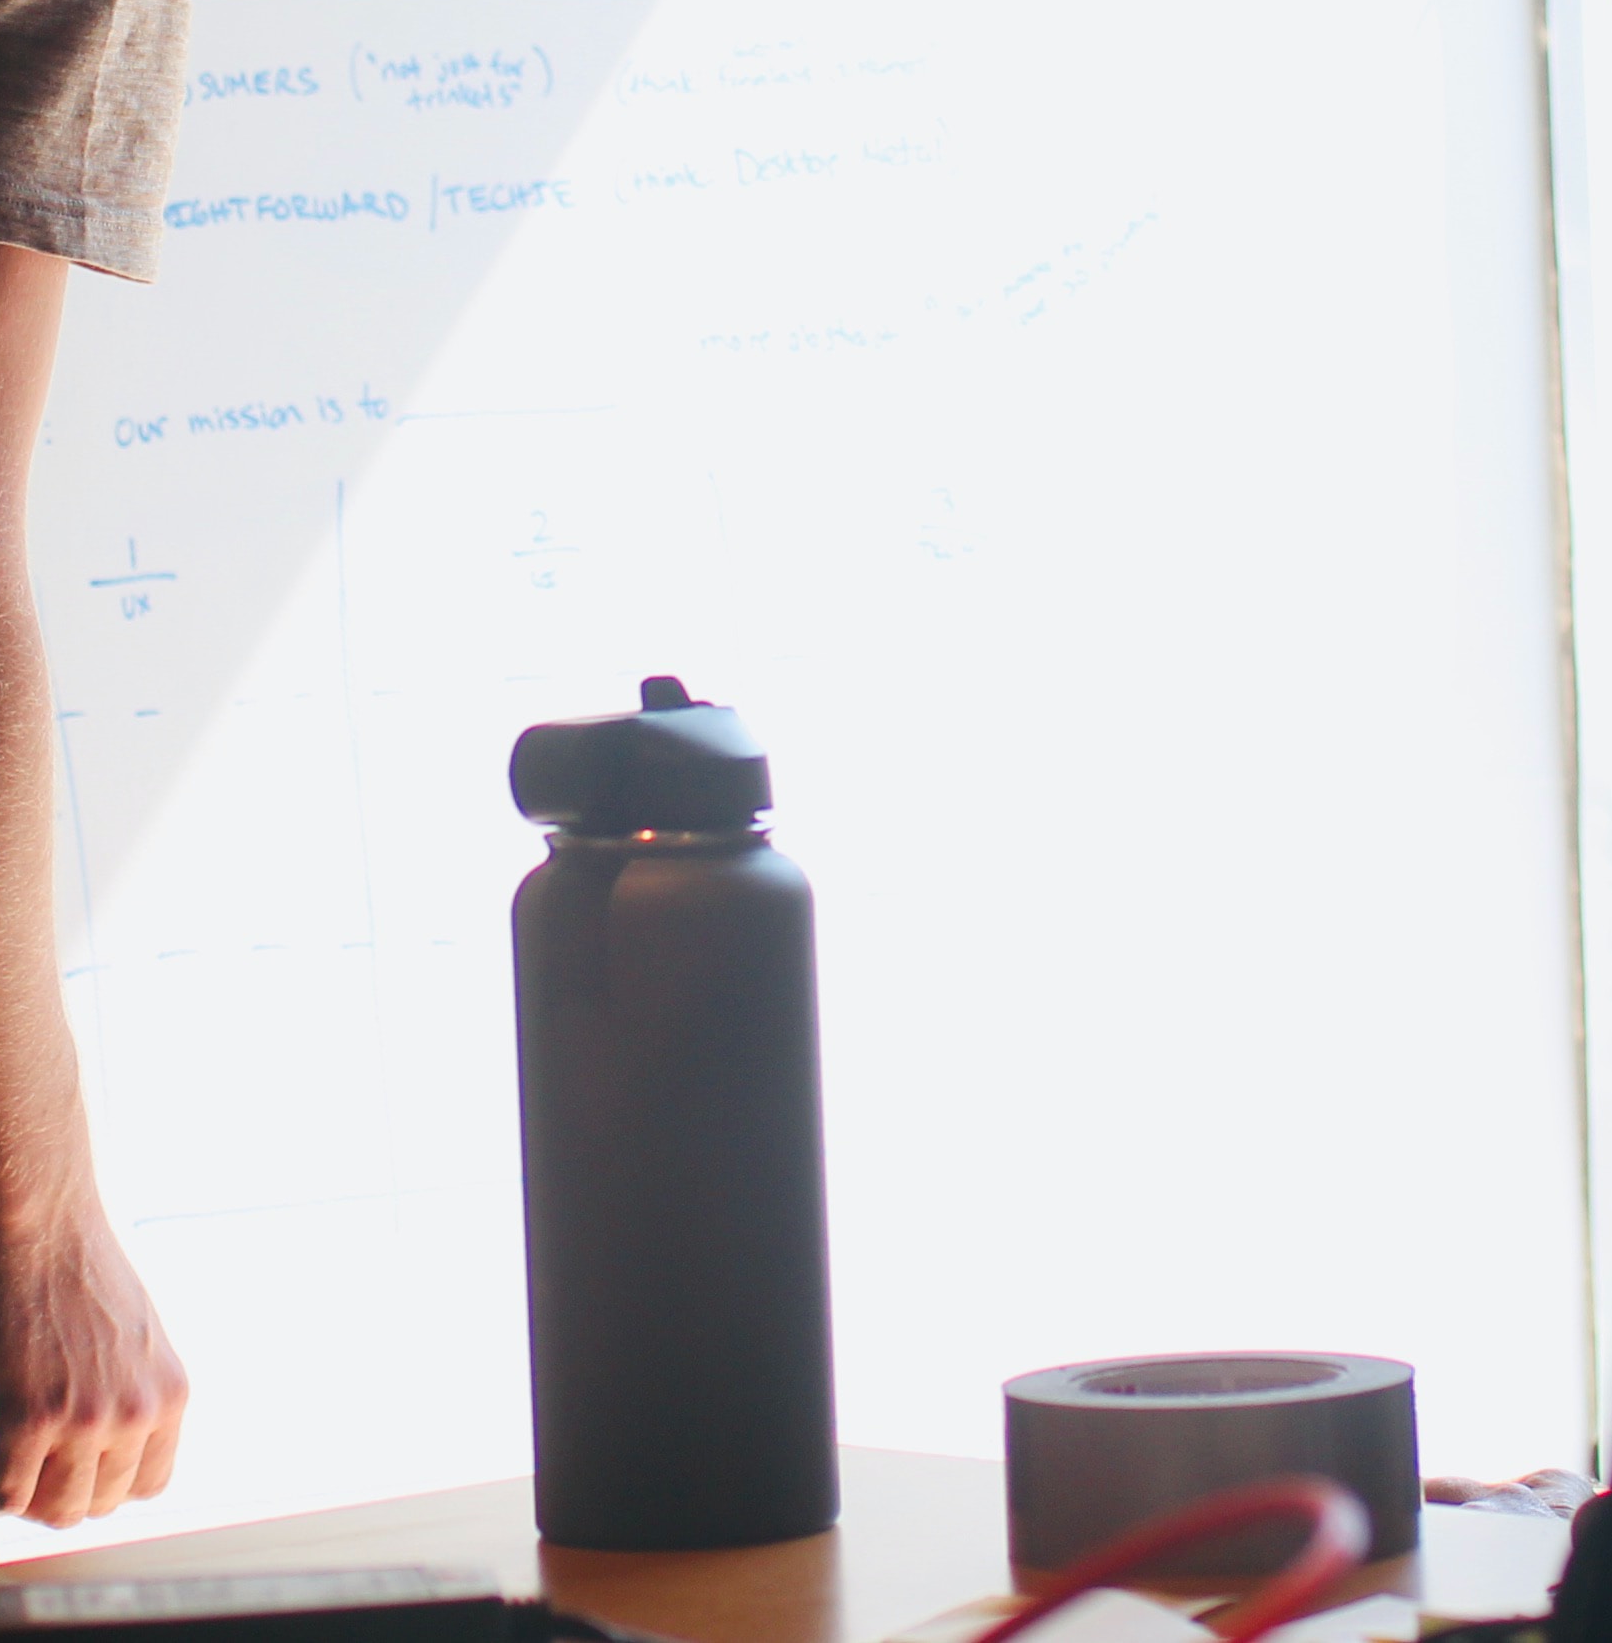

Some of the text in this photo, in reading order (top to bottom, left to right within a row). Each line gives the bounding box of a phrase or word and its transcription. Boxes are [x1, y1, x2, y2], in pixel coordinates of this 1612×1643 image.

[113, 383, 393, 451] Our mission is to
